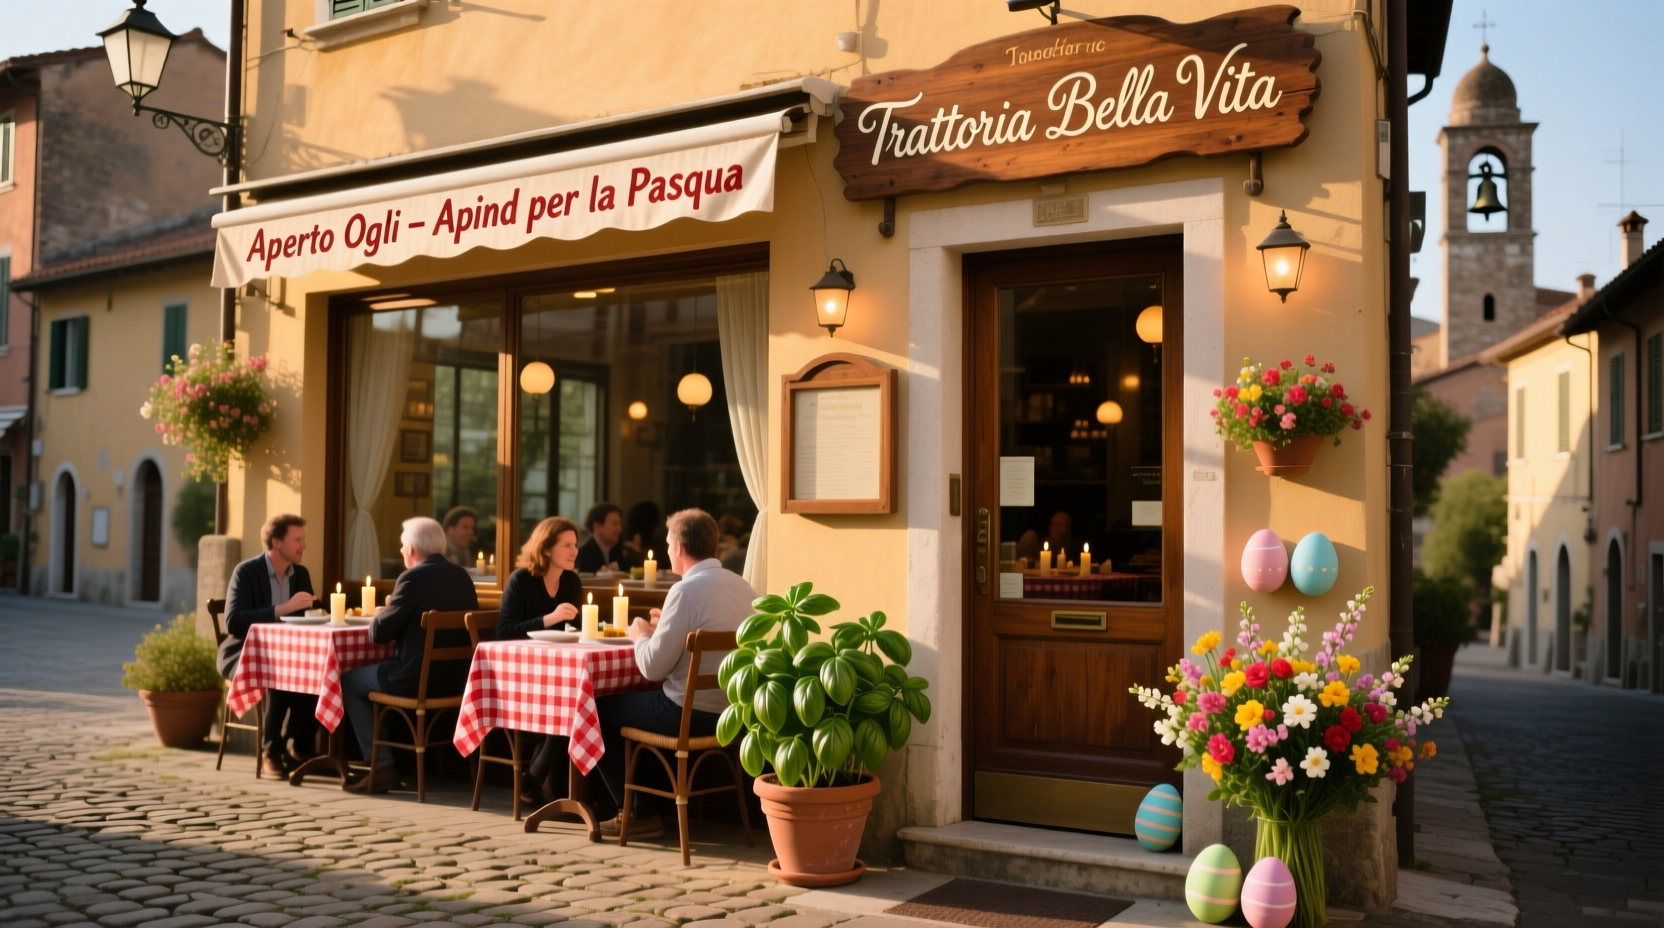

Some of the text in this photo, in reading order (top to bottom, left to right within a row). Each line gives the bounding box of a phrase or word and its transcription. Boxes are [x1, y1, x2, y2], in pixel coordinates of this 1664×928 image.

[858, 43, 1284, 165] Trattoria Bella Vita
[246, 224, 335, 271] Aperto
[344, 209, 402, 258] Ogli
[432, 187, 520, 244] Apind
[526, 190, 580, 234] per
[589, 175, 616, 213] la
[627, 164, 744, 210] Pasqua
